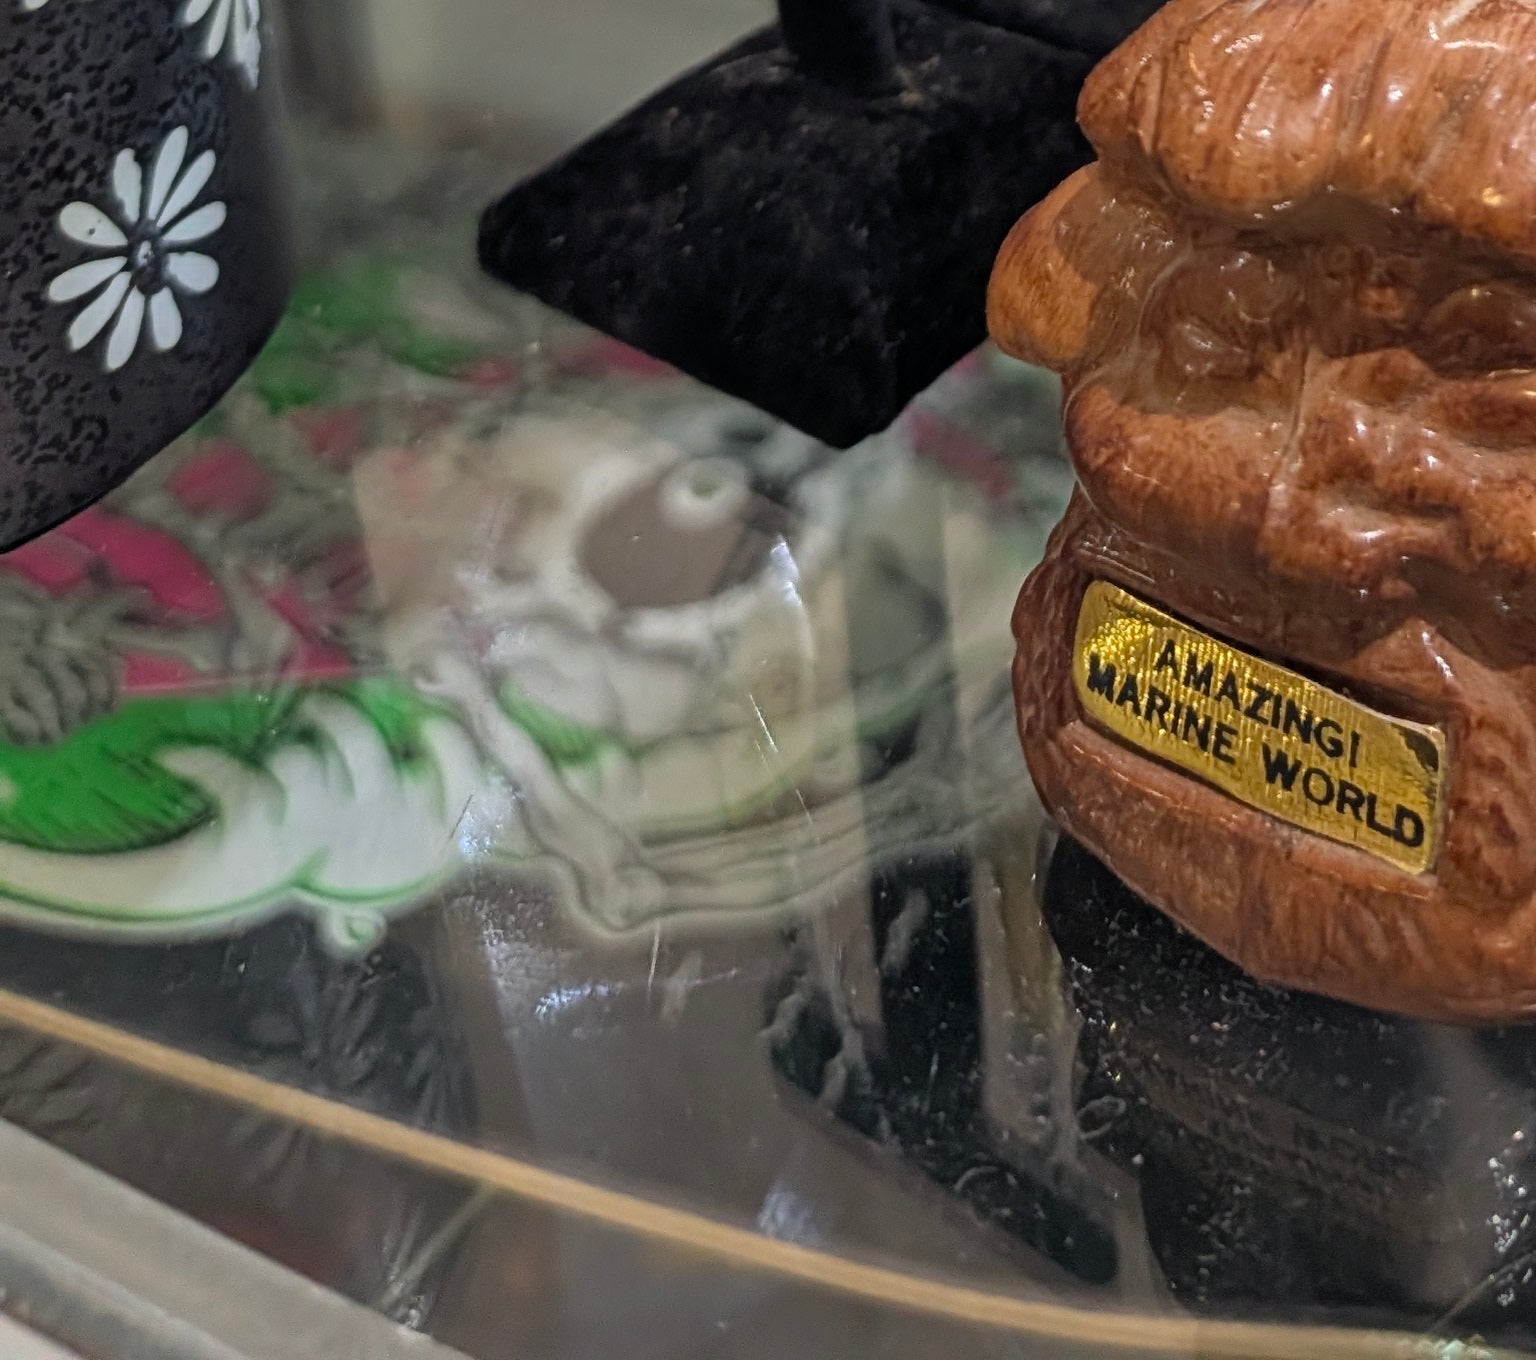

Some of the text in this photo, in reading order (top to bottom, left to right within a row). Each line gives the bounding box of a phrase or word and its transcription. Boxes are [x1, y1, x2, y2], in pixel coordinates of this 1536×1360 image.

[1087, 653, 1425, 848] MARINE WORLD
[1155, 638, 1360, 768] AMAZING!
